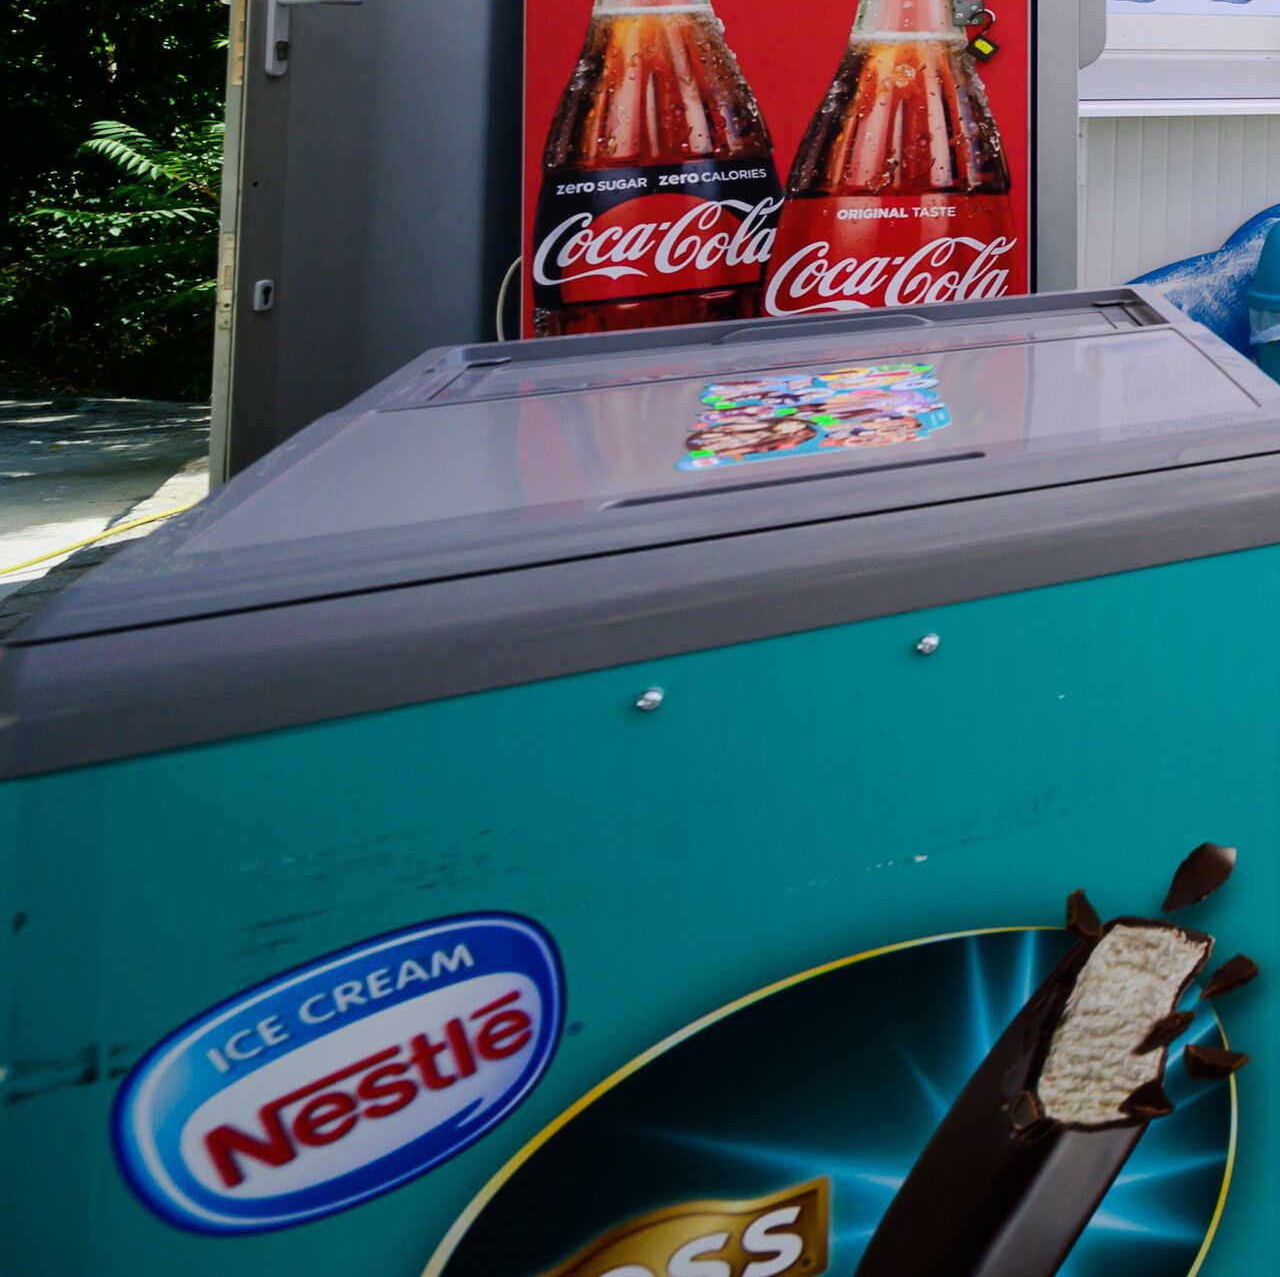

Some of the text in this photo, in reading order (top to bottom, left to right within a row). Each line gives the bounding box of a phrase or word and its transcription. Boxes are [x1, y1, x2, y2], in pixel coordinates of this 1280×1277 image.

[556, 167, 767, 196] zero SUGAR zero CALORIES
[836, 205, 957, 221] ORIGINAL TASTE
[532, 195, 786, 287] Coca-Cola
[764, 236, 1017, 318] Coca-Cola
[206, 942, 476, 1075] ICE CREAM
[598, 1205, 803, 1277] SS
